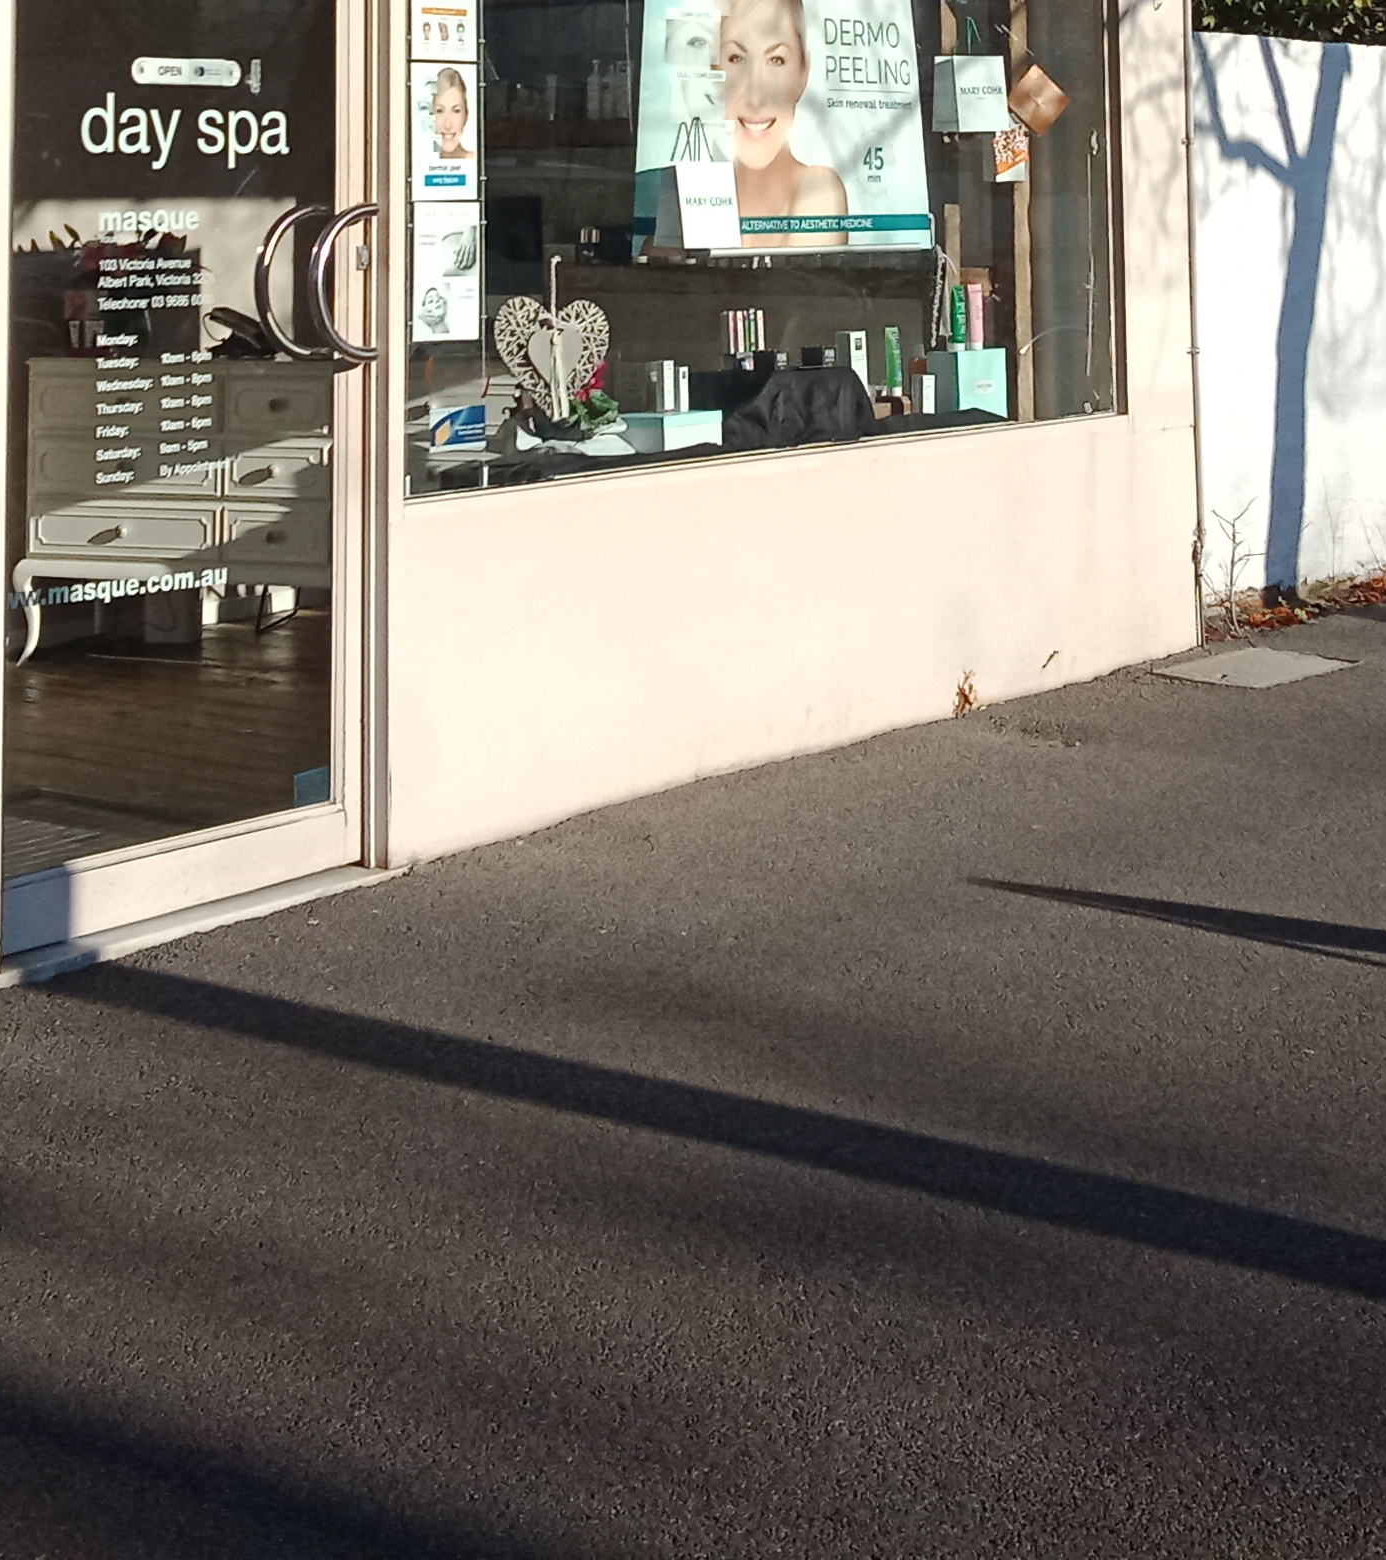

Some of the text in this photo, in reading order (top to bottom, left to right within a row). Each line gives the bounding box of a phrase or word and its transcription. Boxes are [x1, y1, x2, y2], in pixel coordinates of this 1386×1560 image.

[823, 17, 900, 49] DERMO
[157, 65, 183, 77] OPEN
[825, 54, 912, 86] PEELING
[959, 86, 1004, 95] MARY COHR
[826, 97, 913, 111] Skin renewal treatment
[80, 91, 291, 171] day spa
[863, 146, 885, 172] 45
[867, 174, 882, 183] min
[685, 196, 734, 207] MARY COHR
[741, 218, 874, 231] ALTERNATIVE TO AESTHETIC MEDICINE
[118, 257, 156, 271] Victoria
[156, 257, 192, 270] Avenue
[97, 275, 128, 290] Albert
[155, 273, 192, 287] Victoria
[96, 333, 139, 348] Monday:
[96, 356, 140, 370] Tuesday:
[96, 377, 155, 393] Wednesday:
[96, 401, 144, 415] Thursday:
[95, 424, 130, 439] Friday:
[95, 447, 142, 462] Saturday:
[95, 469, 135, 485] Sunday:
[159, 463, 172, 478] By
